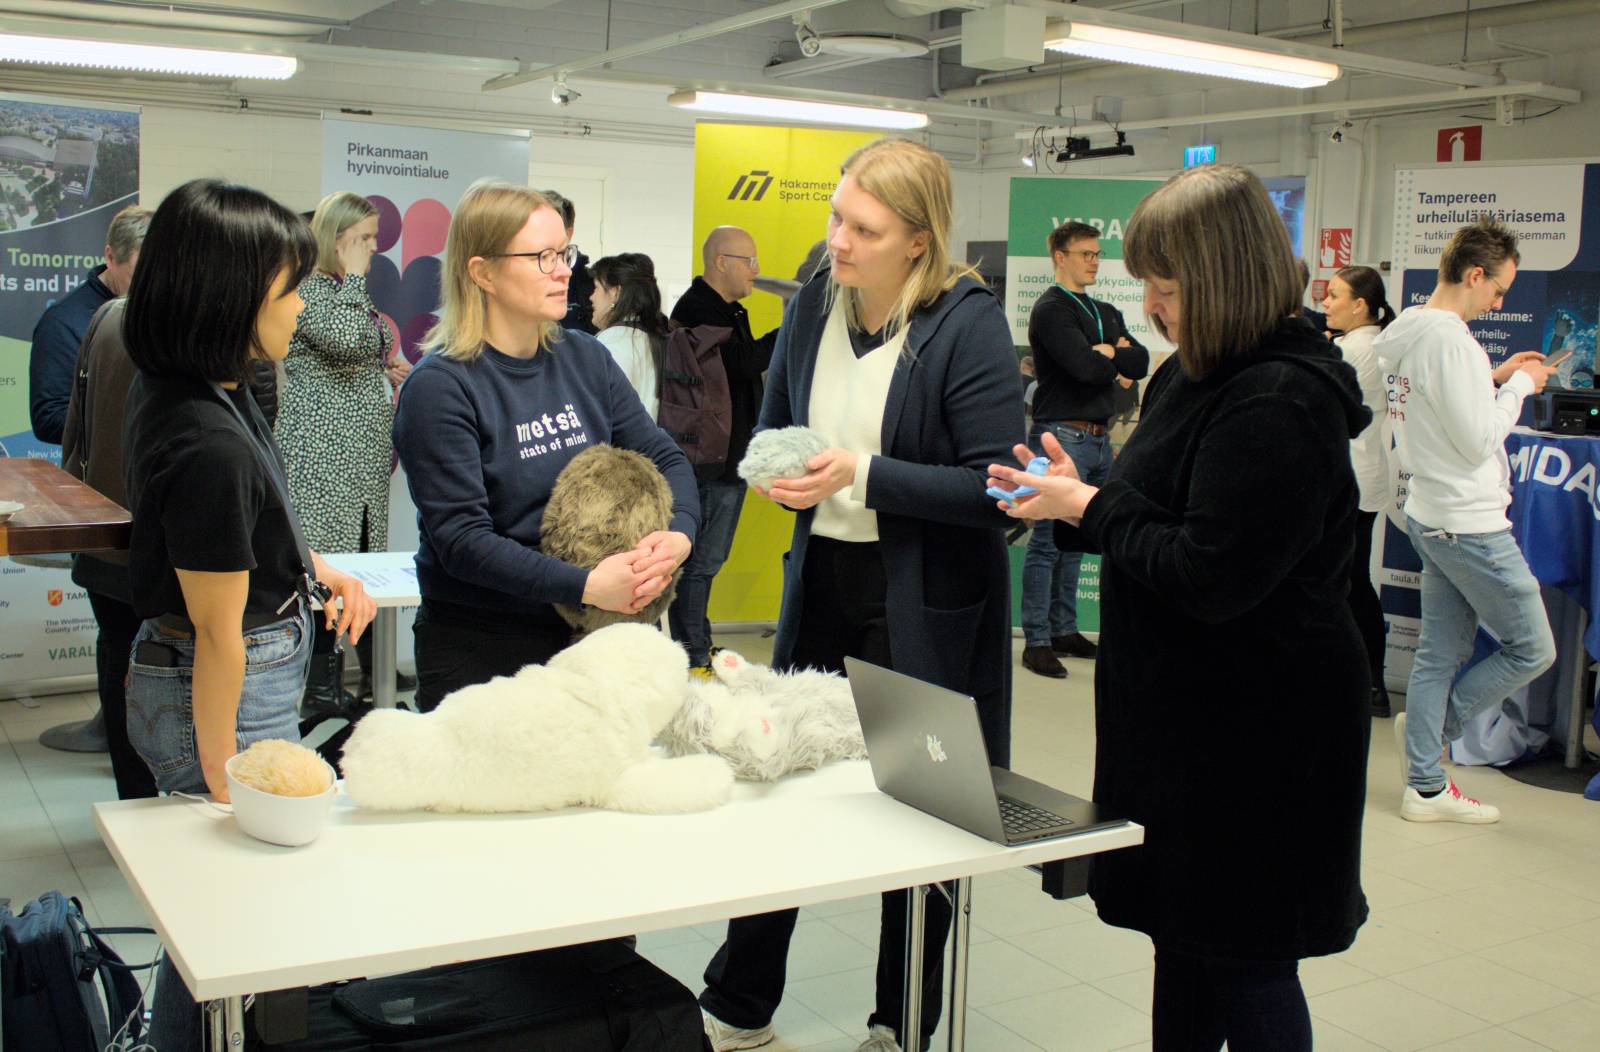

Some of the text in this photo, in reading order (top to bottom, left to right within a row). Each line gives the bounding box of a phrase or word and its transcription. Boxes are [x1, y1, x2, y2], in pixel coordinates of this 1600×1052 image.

[347, 142, 428, 161] Pirkanmaan
[347, 160, 449, 179] hyvinvointialue
[779, 190, 810, 204] Sport
[1418, 191, 1497, 207] Tampereen
[1414, 244, 1444, 255] liikun
[24, 274, 59, 292] and
[516, 403, 582, 443] metsä
[520, 431, 587, 460] state of mind
